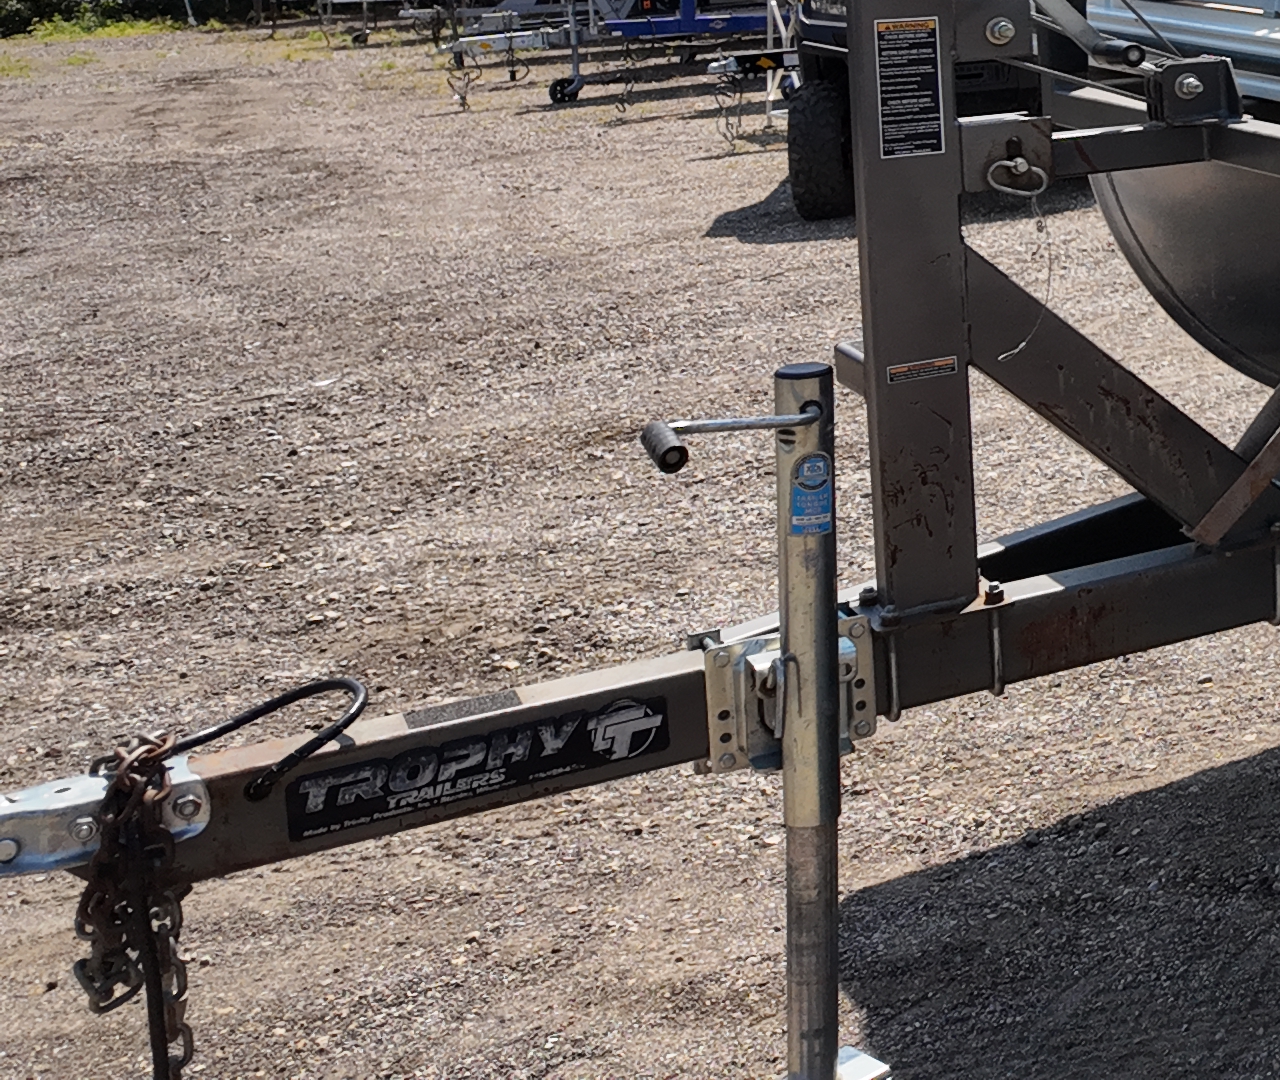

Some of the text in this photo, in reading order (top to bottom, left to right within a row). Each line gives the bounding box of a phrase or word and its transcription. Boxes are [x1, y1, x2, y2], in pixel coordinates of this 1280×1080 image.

[892, 21, 930, 30] WARNING
[299, 715, 583, 815] TROPHY
[386, 767, 507, 810] TRAILERS
